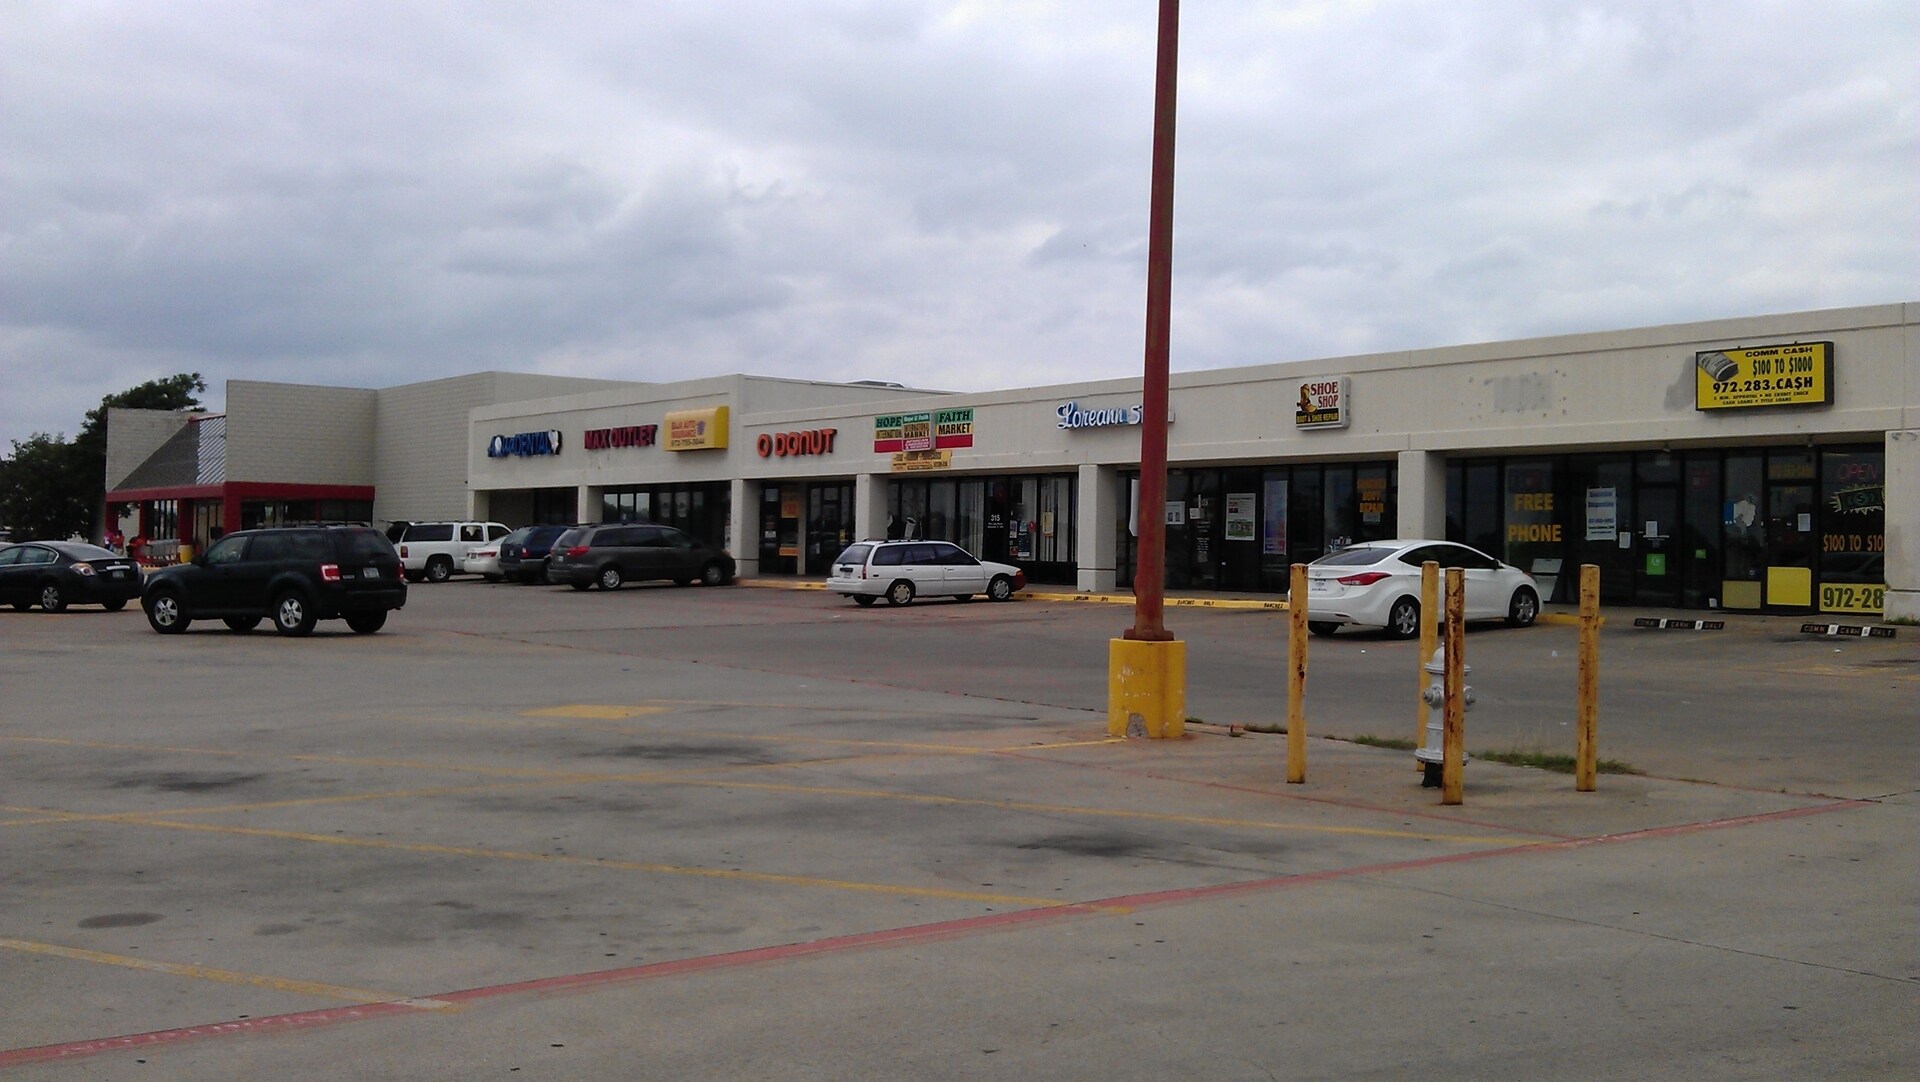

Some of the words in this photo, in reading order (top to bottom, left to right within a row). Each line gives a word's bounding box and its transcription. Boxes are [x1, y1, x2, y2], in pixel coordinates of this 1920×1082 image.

[1745, 349, 1779, 358] COMM
[1783, 346, 1813, 355] CASH
[1752, 358, 1771, 377] $100
[1775, 357, 1785, 374] TO
[1788, 355, 1813, 376] $1000
[1310, 381, 1339, 396] SHOE
[1712, 376, 1813, 394] 972.283.CA$H
[1317, 394, 1339, 409] SHOP
[876, 416, 902, 428] HOPE
[939, 410, 971, 423] FAITH
[1056, 401, 1128, 429] Loreann
[584, 428, 611, 449] MAX
[611, 424, 658, 448] OUTLET
[904, 431, 930, 439] MARKET
[938, 423, 971, 435] MARKET
[757, 433, 773, 458] O
[775, 428, 837, 456] DONUT
[1838, 463, 1878, 480] OPEN
[1513, 493, 1554, 511] FREE
[1507, 524, 1562, 542] PHONE
[1823, 534, 1845, 552] $100
[1849, 534, 1862, 551] TO
